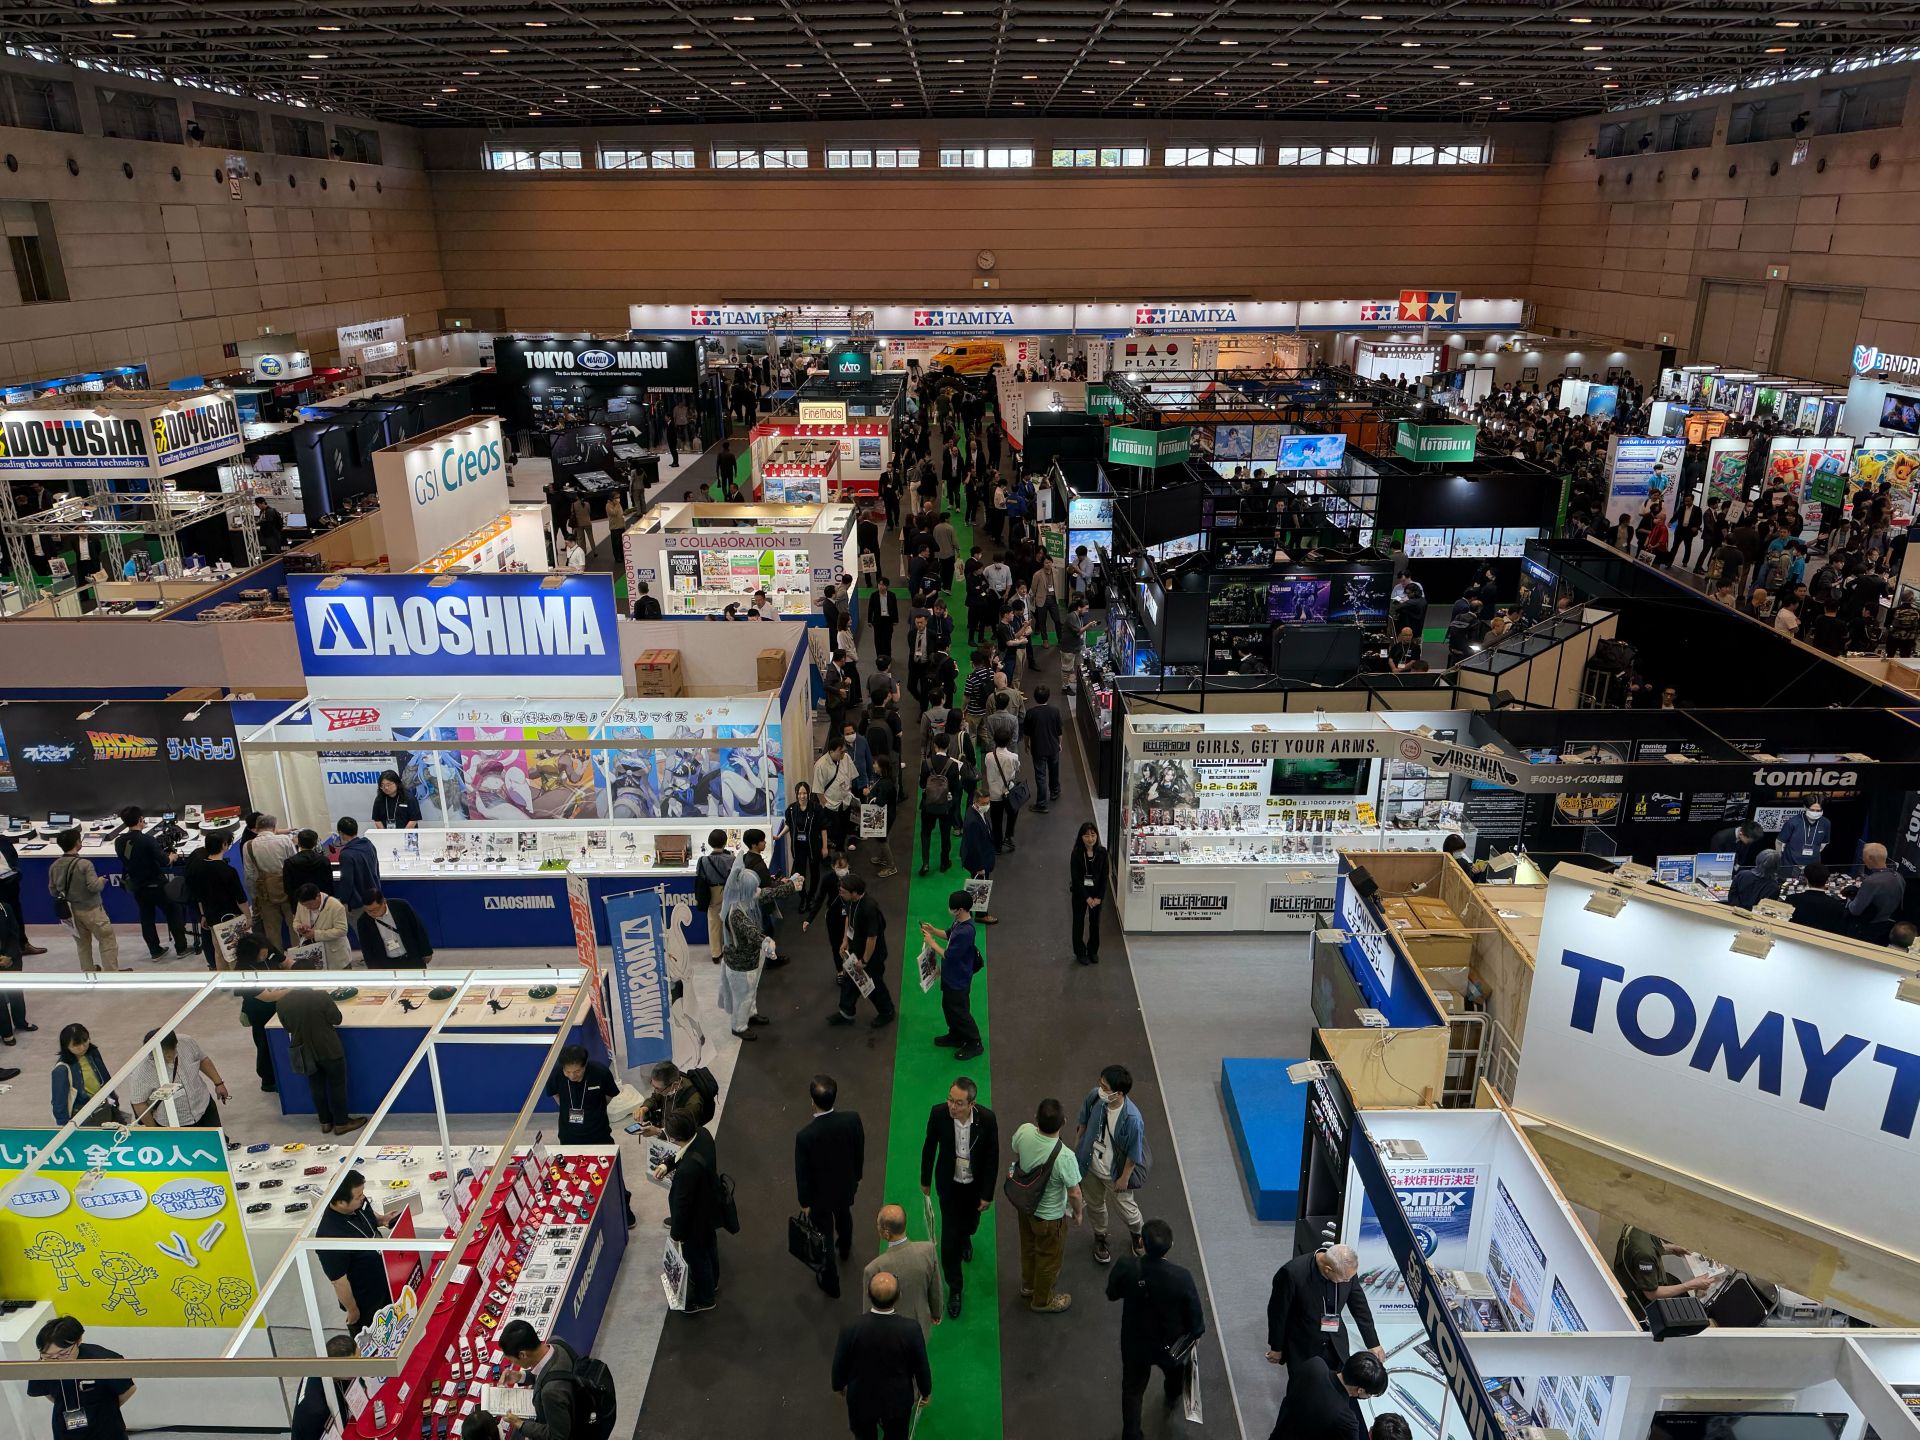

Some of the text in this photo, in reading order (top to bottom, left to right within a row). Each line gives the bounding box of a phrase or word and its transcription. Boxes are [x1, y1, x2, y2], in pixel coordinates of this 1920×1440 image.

[946, 311, 1014, 325] TAMIYA
[1168, 309, 1237, 323] TAMIYA
[524, 351, 574, 369] TOKYO
[618, 351, 668, 369] MARUI
[1125, 359, 1178, 367] PLATZ
[1874, 352, 1920, 376] BANDA
[840, 362, 860, 373] KATO
[803, 409, 842, 420] FineMolds
[165, 401, 239, 451] DOYUSHA
[4, 419, 148, 457] DOYUSHA
[1420, 438, 1471, 451] KOTOBUKIYA
[204, 441, 217, 453] model
[1112, 440, 1153, 456] KOTOBUKIYA
[0, 460, 26, 469] eading
[26, 459, 39, 468] the
[40, 459, 63, 468] world
[64, 459, 72, 468] in
[74, 459, 99, 468] model
[415, 440, 500, 505] GSI Creos
[681, 537, 785, 548] COLLABORATION
[833, 534, 843, 562] NEW
[622, 534, 636, 608] COLLABORATIO
[374, 596, 605, 657] AOSHIMA
[325, 708, 375, 719] マクロス
[333, 716, 377, 729] モデラーズ
[87, 731, 143, 747] BACK
[106, 746, 157, 760] FUTURE
[1196, 739, 1379, 756] GIRLS, GET YOUR ARMS.
[1752, 767, 1858, 787] tomica
[1240, 782, 1258, 791] 公演
[1635, 804, 1647, 812] 64
[500, 896, 556, 909] AOSHIMA
[666, 893, 697, 907] AOSH
[1354, 896, 1383, 955] TOMYTEC
[1560, 948, 1920, 1140] TOMYT
[83, 1144, 218, 1167] 全ての人へ
[1390, 1174, 1479, 1187] 6年秋頃刊行決定!
[151, 1185, 224, 1205] 少ないパーツで
